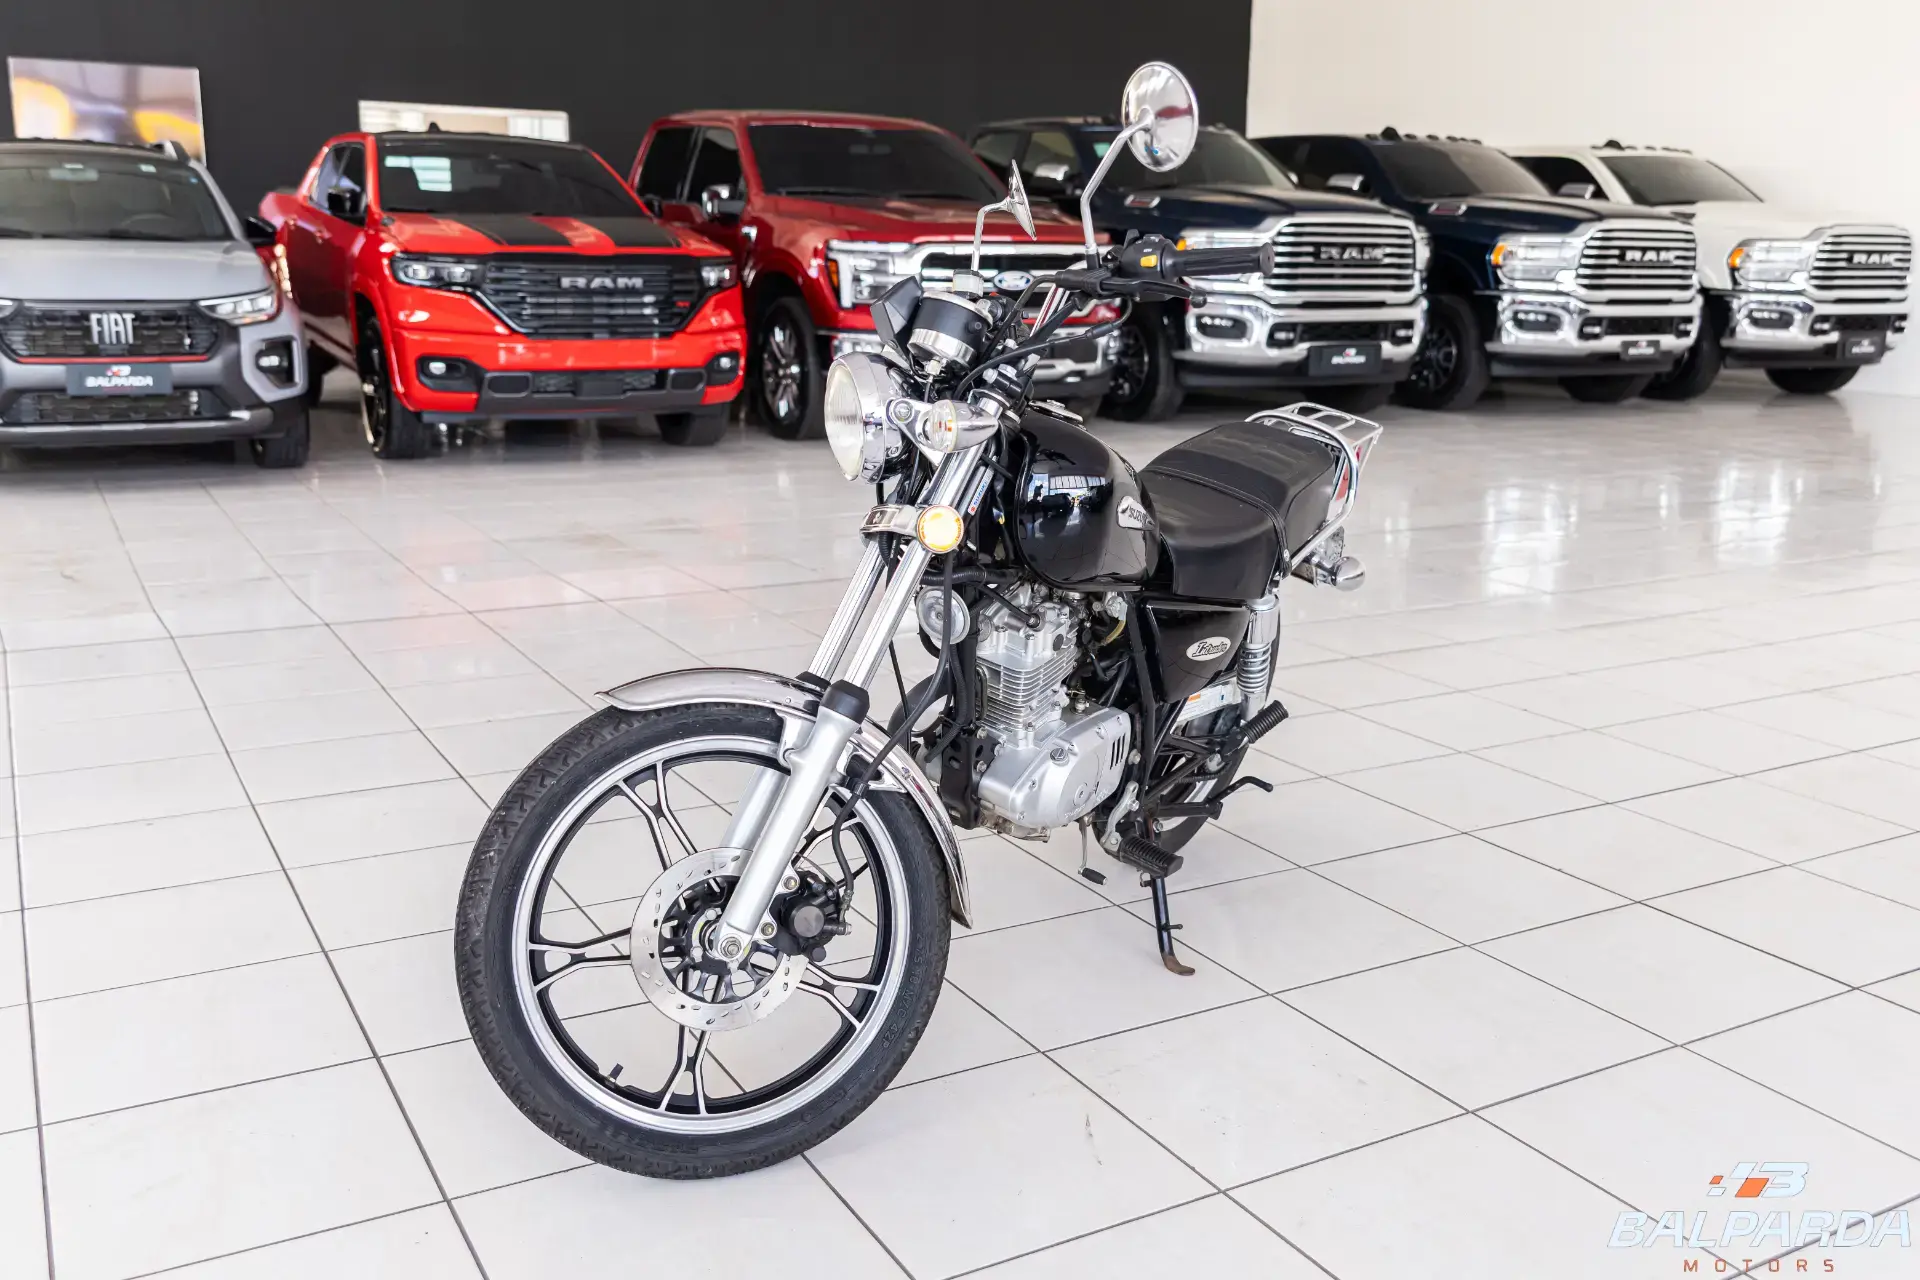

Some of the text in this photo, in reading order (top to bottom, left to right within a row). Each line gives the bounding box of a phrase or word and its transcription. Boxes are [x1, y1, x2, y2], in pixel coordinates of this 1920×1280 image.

[1320, 246, 1384, 260] RAM
[1625, 250, 1675, 262] RAM
[1852, 253, 1893, 264] RAM
[560, 276, 643, 289] RAM
[90, 312, 135, 345] FIAT
